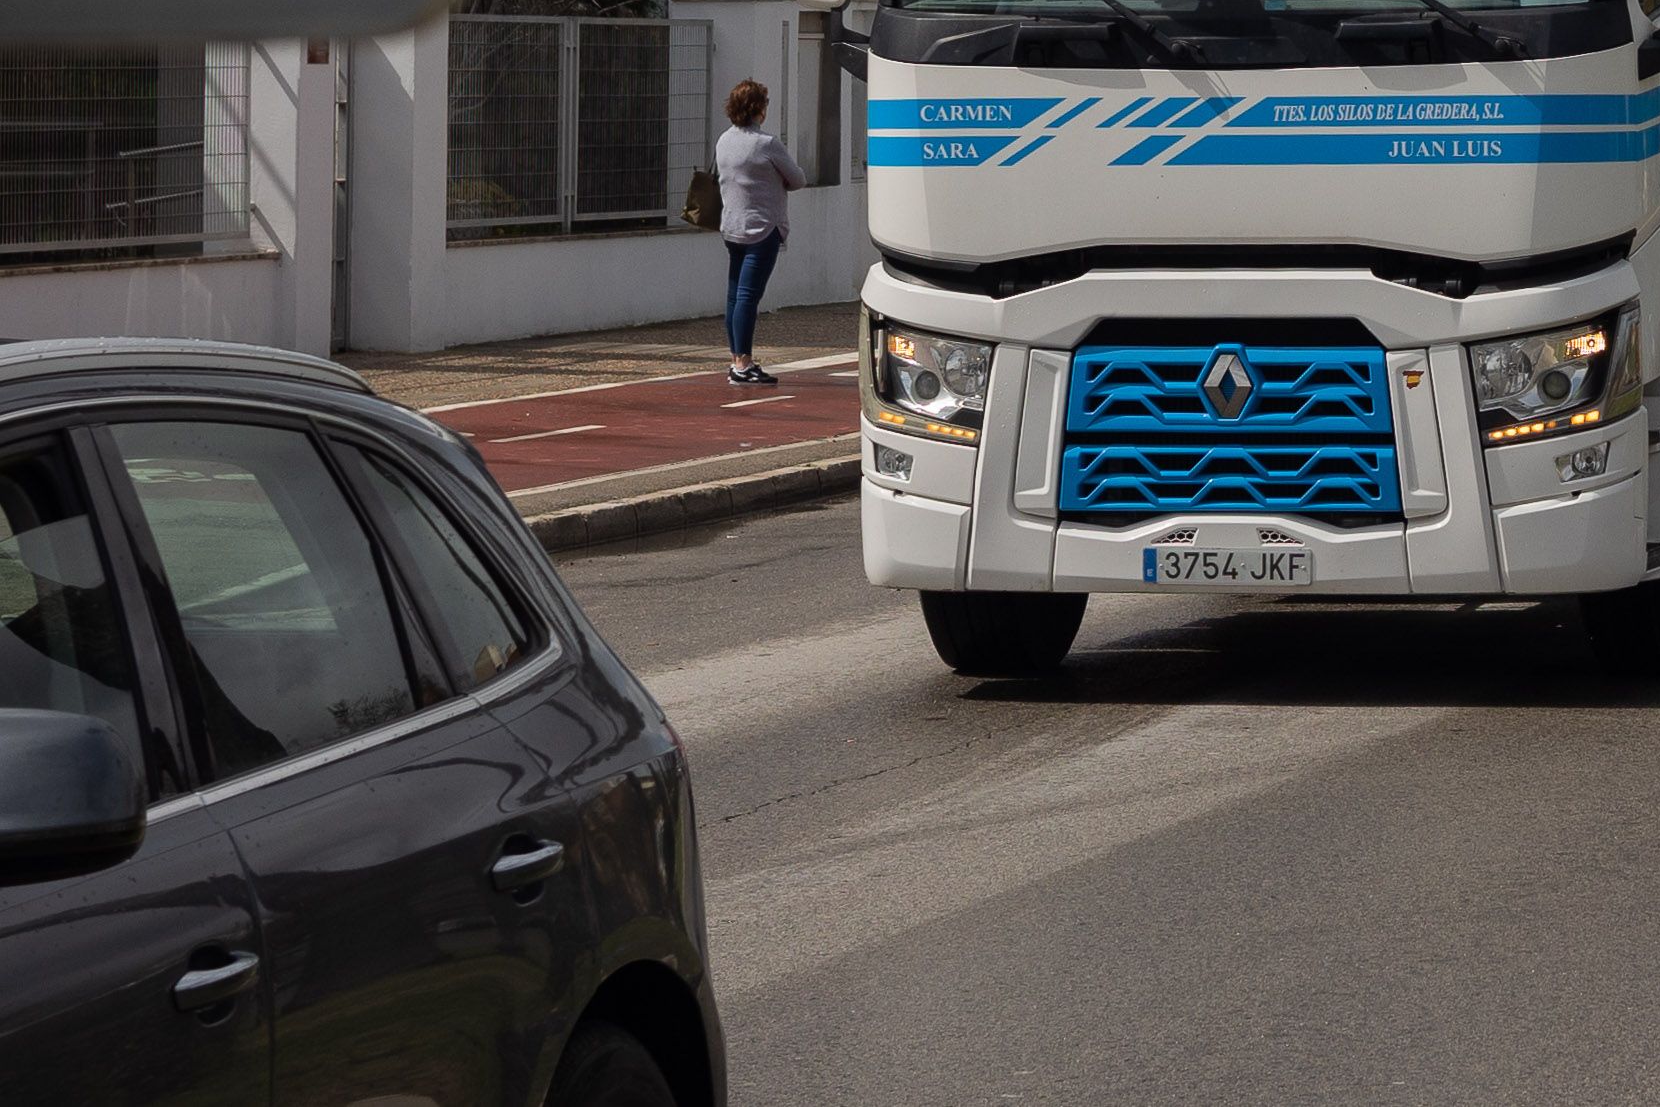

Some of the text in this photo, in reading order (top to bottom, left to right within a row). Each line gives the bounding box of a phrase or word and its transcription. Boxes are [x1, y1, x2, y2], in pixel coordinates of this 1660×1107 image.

[920, 105, 1012, 122] CARMEN
[1273, 102, 1504, 122] TTES. LOS SILOS DE LA GREDERA, S.L.
[923, 142, 979, 160] SARA
[1388, 141, 1502, 157] JUAN LUIS
[1164, 552, 1239, 580] 3754
[1250, 553, 1305, 580] JKF
